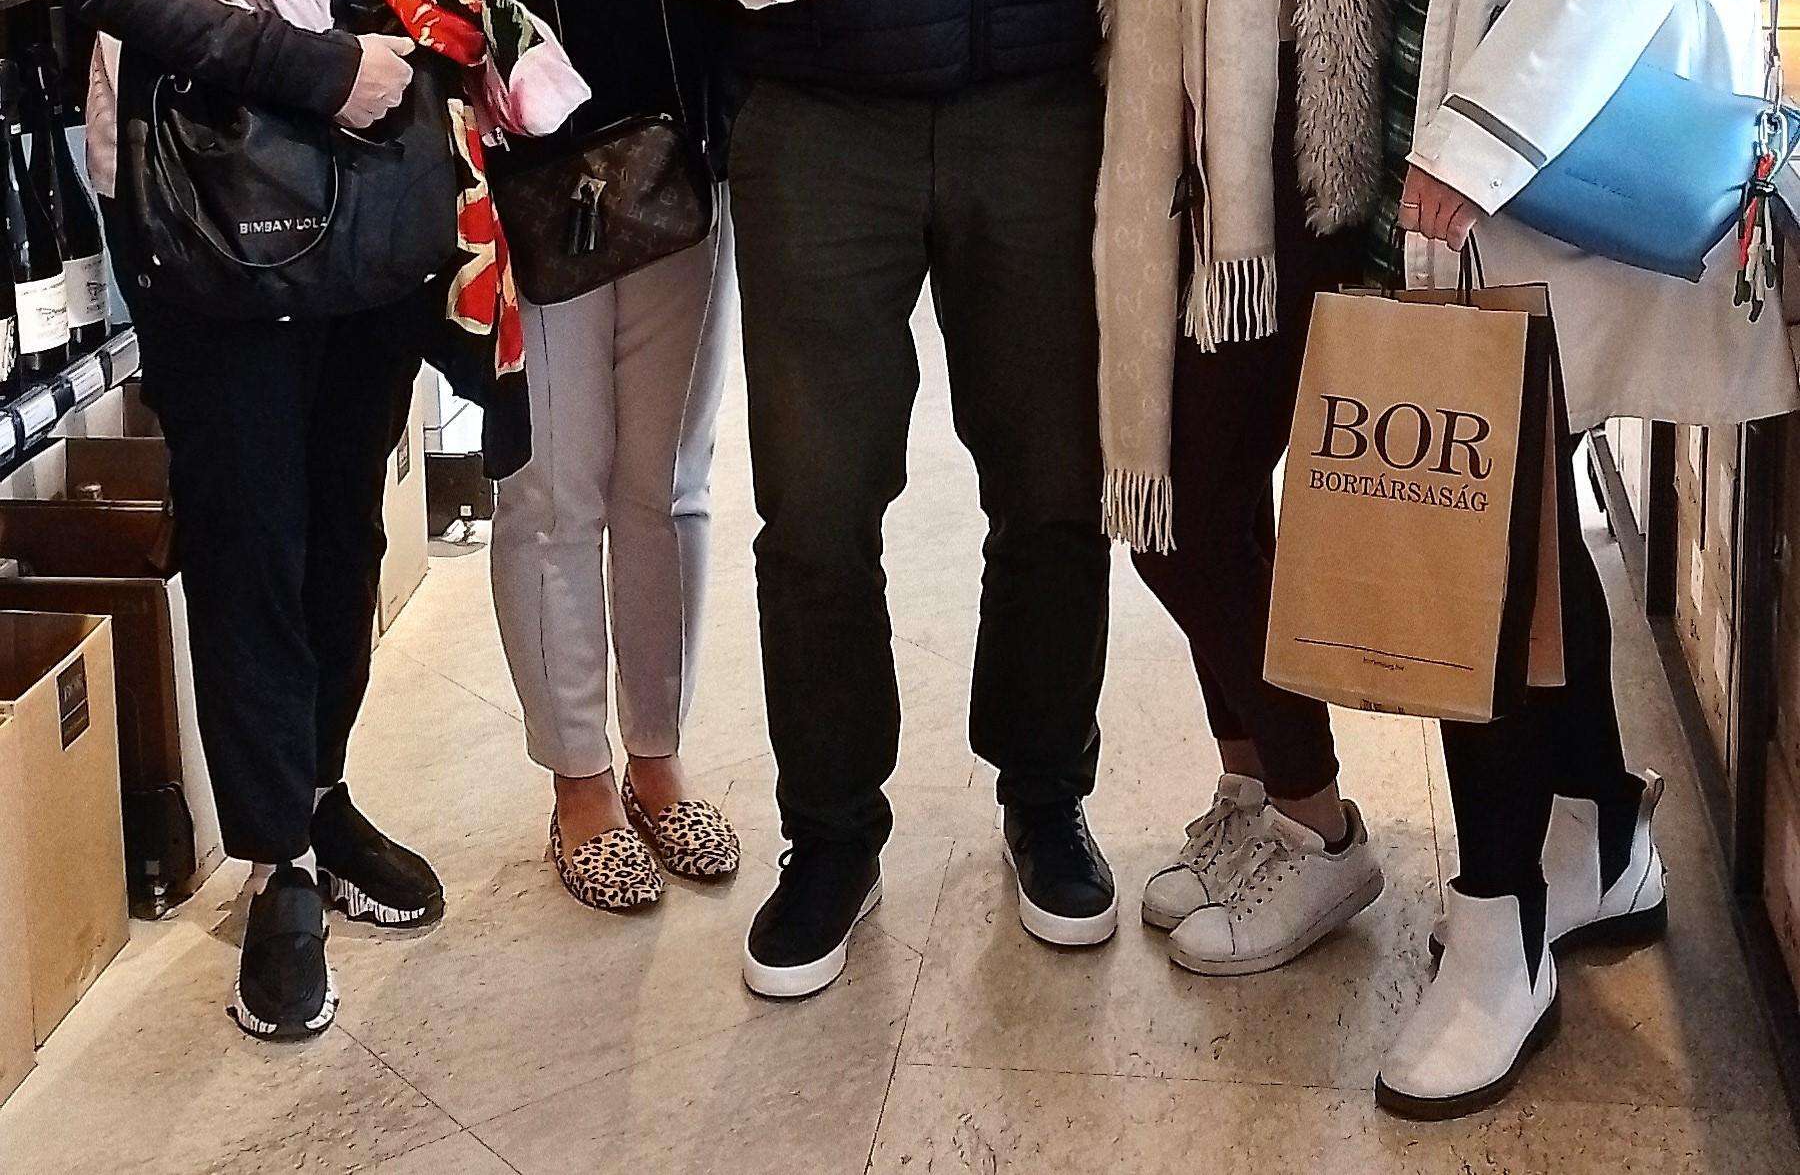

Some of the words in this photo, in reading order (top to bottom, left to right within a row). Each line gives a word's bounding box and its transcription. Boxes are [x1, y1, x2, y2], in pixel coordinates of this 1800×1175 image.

[239, 219, 282, 234] BIMBA
[283, 219, 292, 230] Y
[1310, 393, 1493, 480] BOR
[1309, 468, 1489, 512] BORTÁRSASÁG
